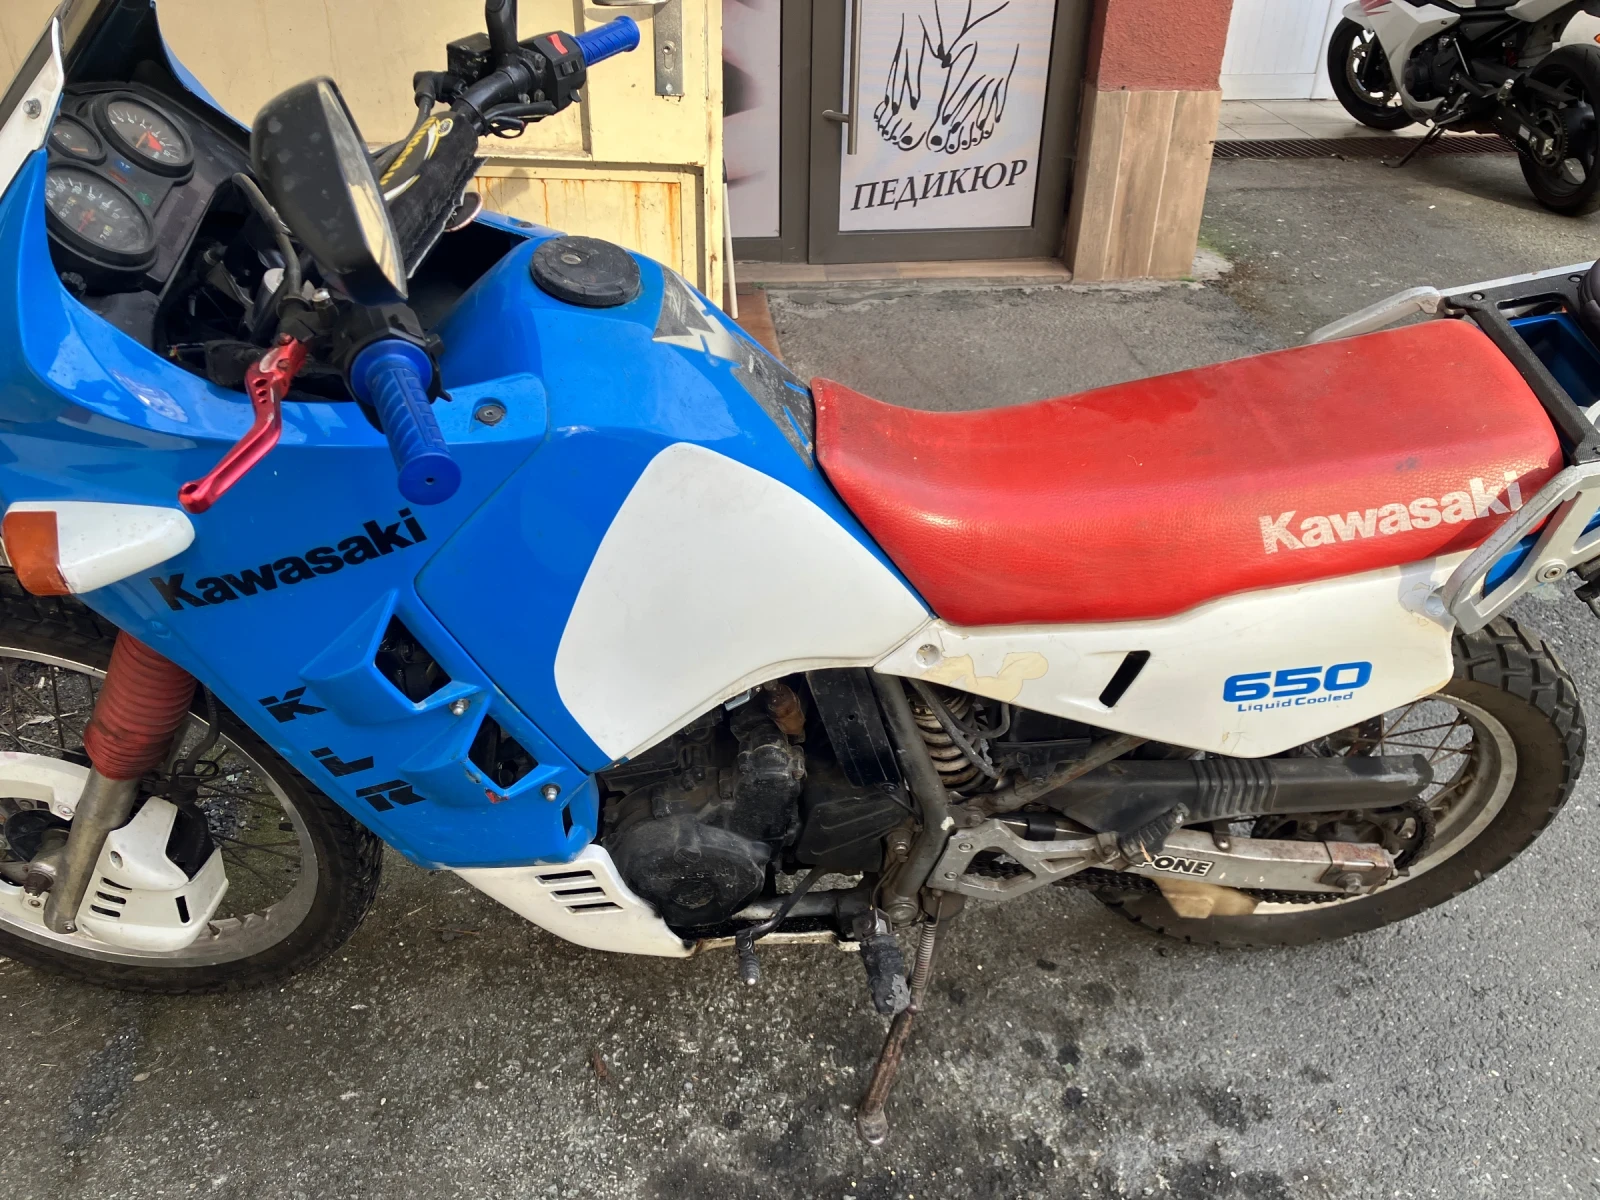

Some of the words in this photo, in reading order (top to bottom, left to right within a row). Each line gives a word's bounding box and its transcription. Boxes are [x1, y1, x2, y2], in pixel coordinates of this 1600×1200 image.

[850, 159, 1028, 211] ПЕДИКЮР
[1258, 471, 1524, 554] Kawasaki
[150, 507, 427, 611] Kawasaki
[1222, 661, 1373, 702] 650
[1237, 698, 1292, 713] Liquid
[1294, 691, 1354, 706] Cooled
[1136, 854, 1214, 877] ONE
